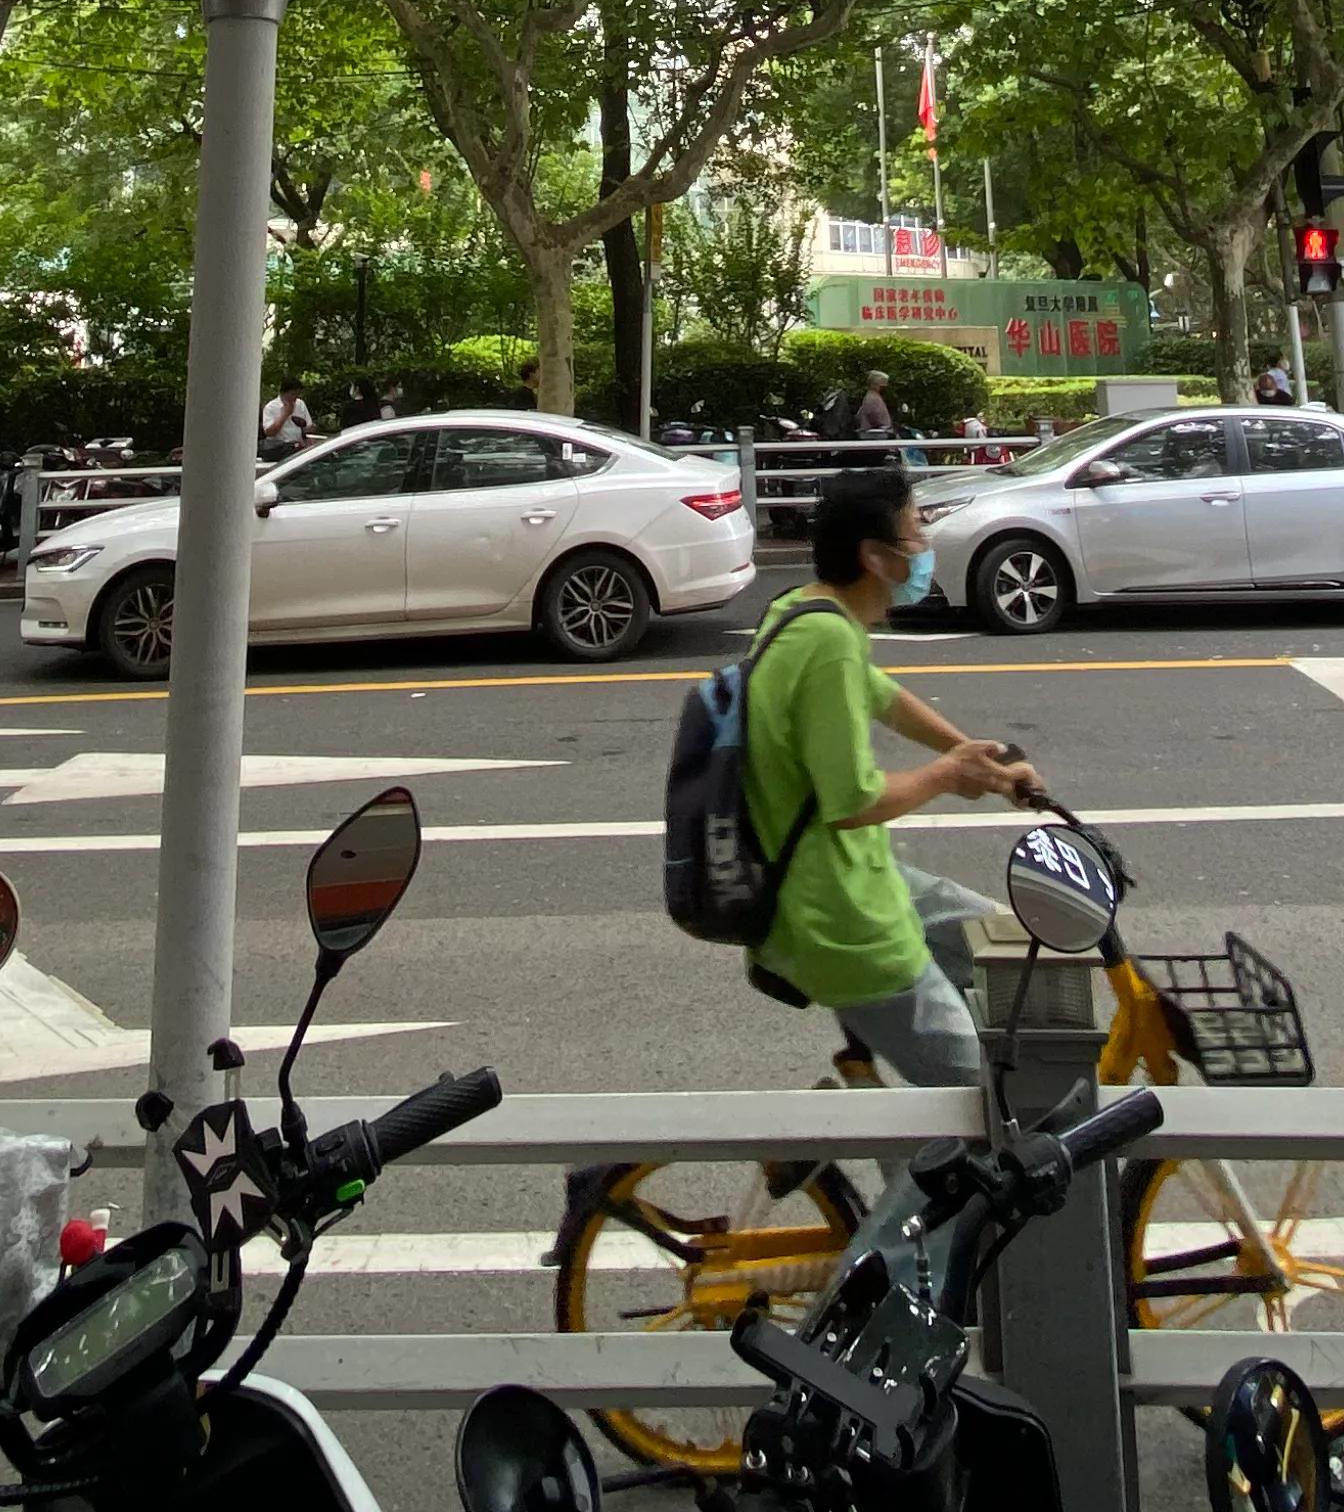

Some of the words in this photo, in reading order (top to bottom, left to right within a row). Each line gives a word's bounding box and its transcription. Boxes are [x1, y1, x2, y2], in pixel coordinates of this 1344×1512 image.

[862, 304, 958, 320] 临床医学研究中心
[1025, 295, 1098, 312] 复旦大学附属
[1005, 317, 1121, 358] 华山医院
